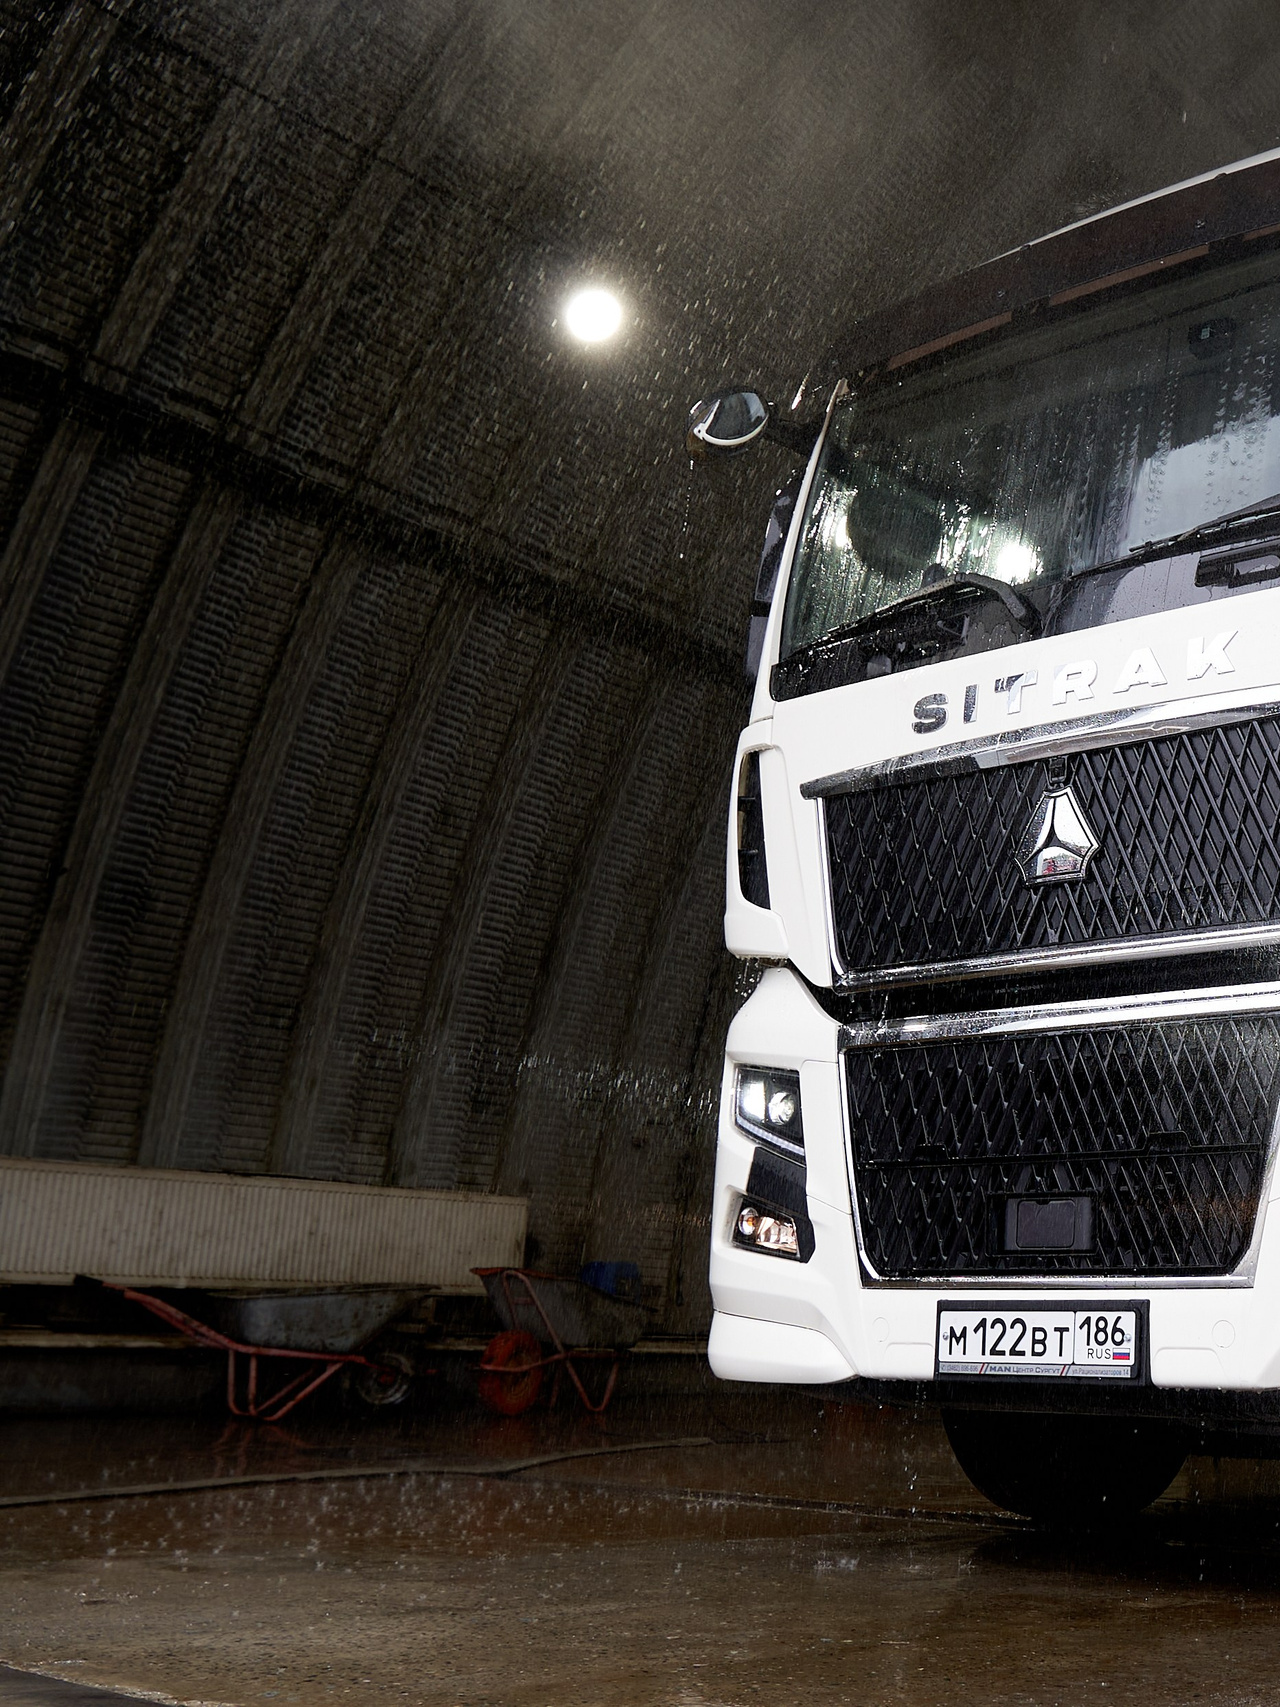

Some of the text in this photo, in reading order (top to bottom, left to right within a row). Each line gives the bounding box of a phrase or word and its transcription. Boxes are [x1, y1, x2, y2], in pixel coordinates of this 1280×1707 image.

[912, 630, 1239, 735] SITRAK
[1079, 1315, 1126, 1347] 186
[1087, 1348, 1112, 1360] RUS
[989, 1365, 1011, 1373] MAN
